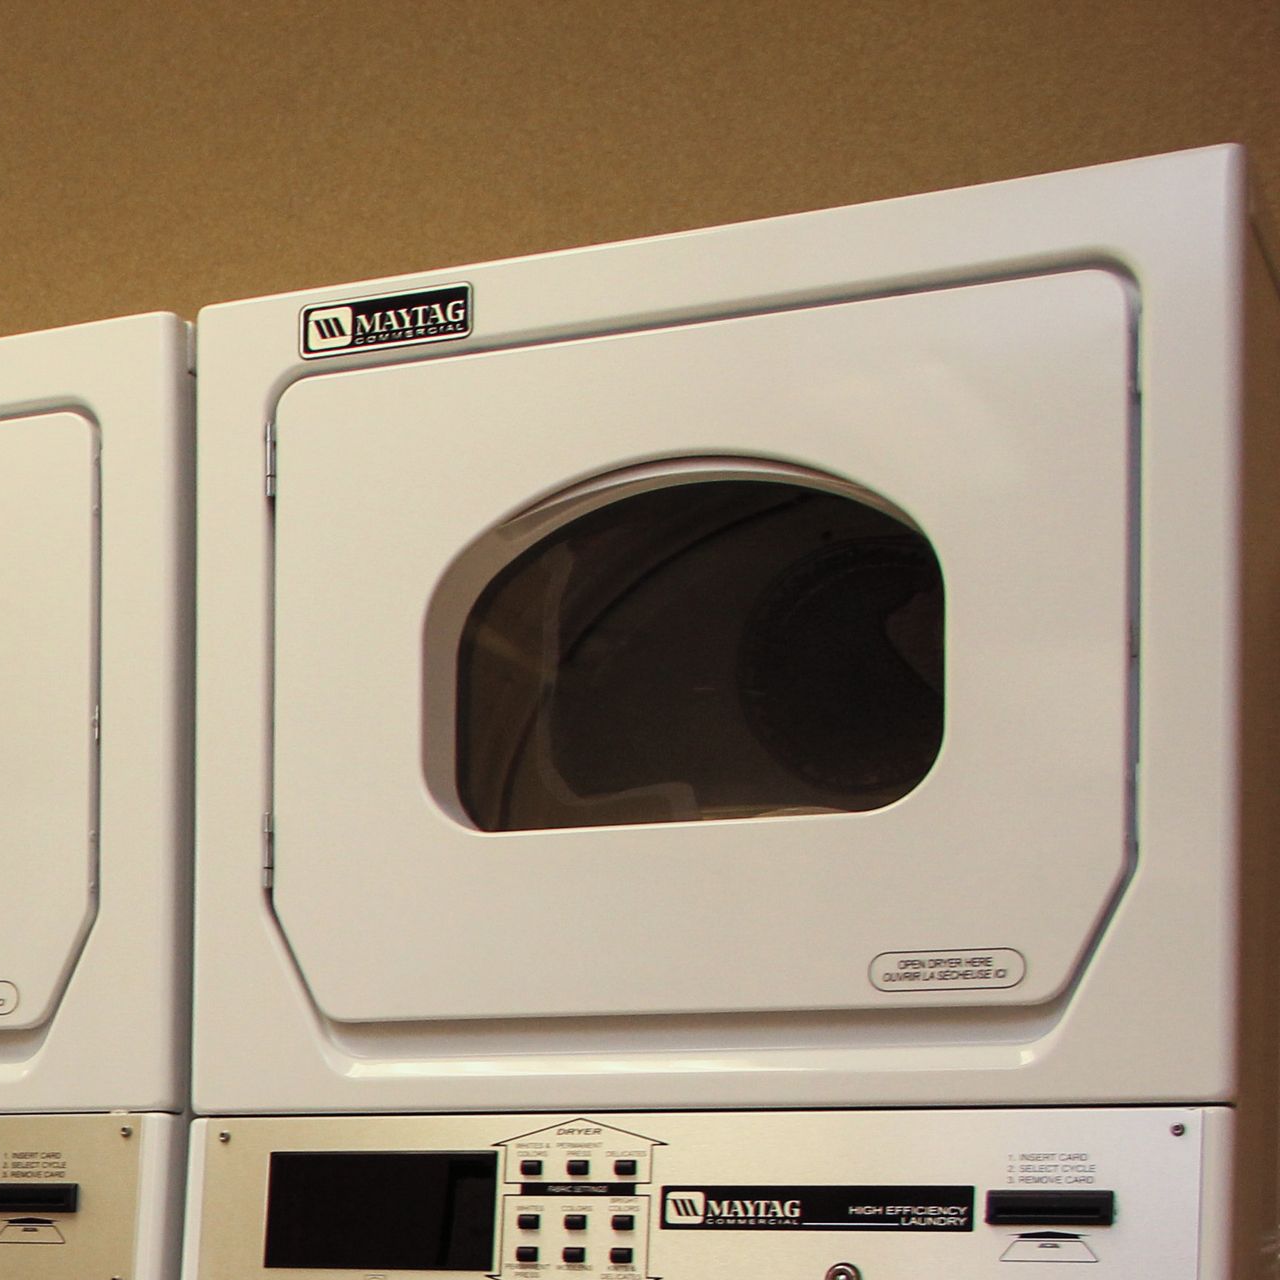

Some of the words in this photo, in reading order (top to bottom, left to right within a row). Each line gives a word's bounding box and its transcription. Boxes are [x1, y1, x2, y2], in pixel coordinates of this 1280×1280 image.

[355, 300, 465, 336] MAYTAG
[354, 323, 464, 345] COMMERCIAL
[898, 959, 925, 969] OPEN
[928, 958, 962, 969] DRYER
[965, 957, 993, 967] HERE
[556, 1127, 602, 1136] DRYER
[1019, 1153, 1057, 1161] INSERT
[1059, 1153, 1089, 1161] CARD
[1019, 1164, 1059, 1172] SELECT
[1061, 1164, 1096, 1172] CYCLE
[1018, 1176, 1063, 1184] REMOVE
[1065, 1176, 1095, 1184] CARD
[706, 1200, 801, 1218] MAYTAG
[848, 1205, 884, 1216] HIGH
[886, 1205, 968, 1216] EFFICIENCY
[705, 1218, 799, 1226] COMMERCIAL
[900, 1216, 967, 1227] LAUNDRY
